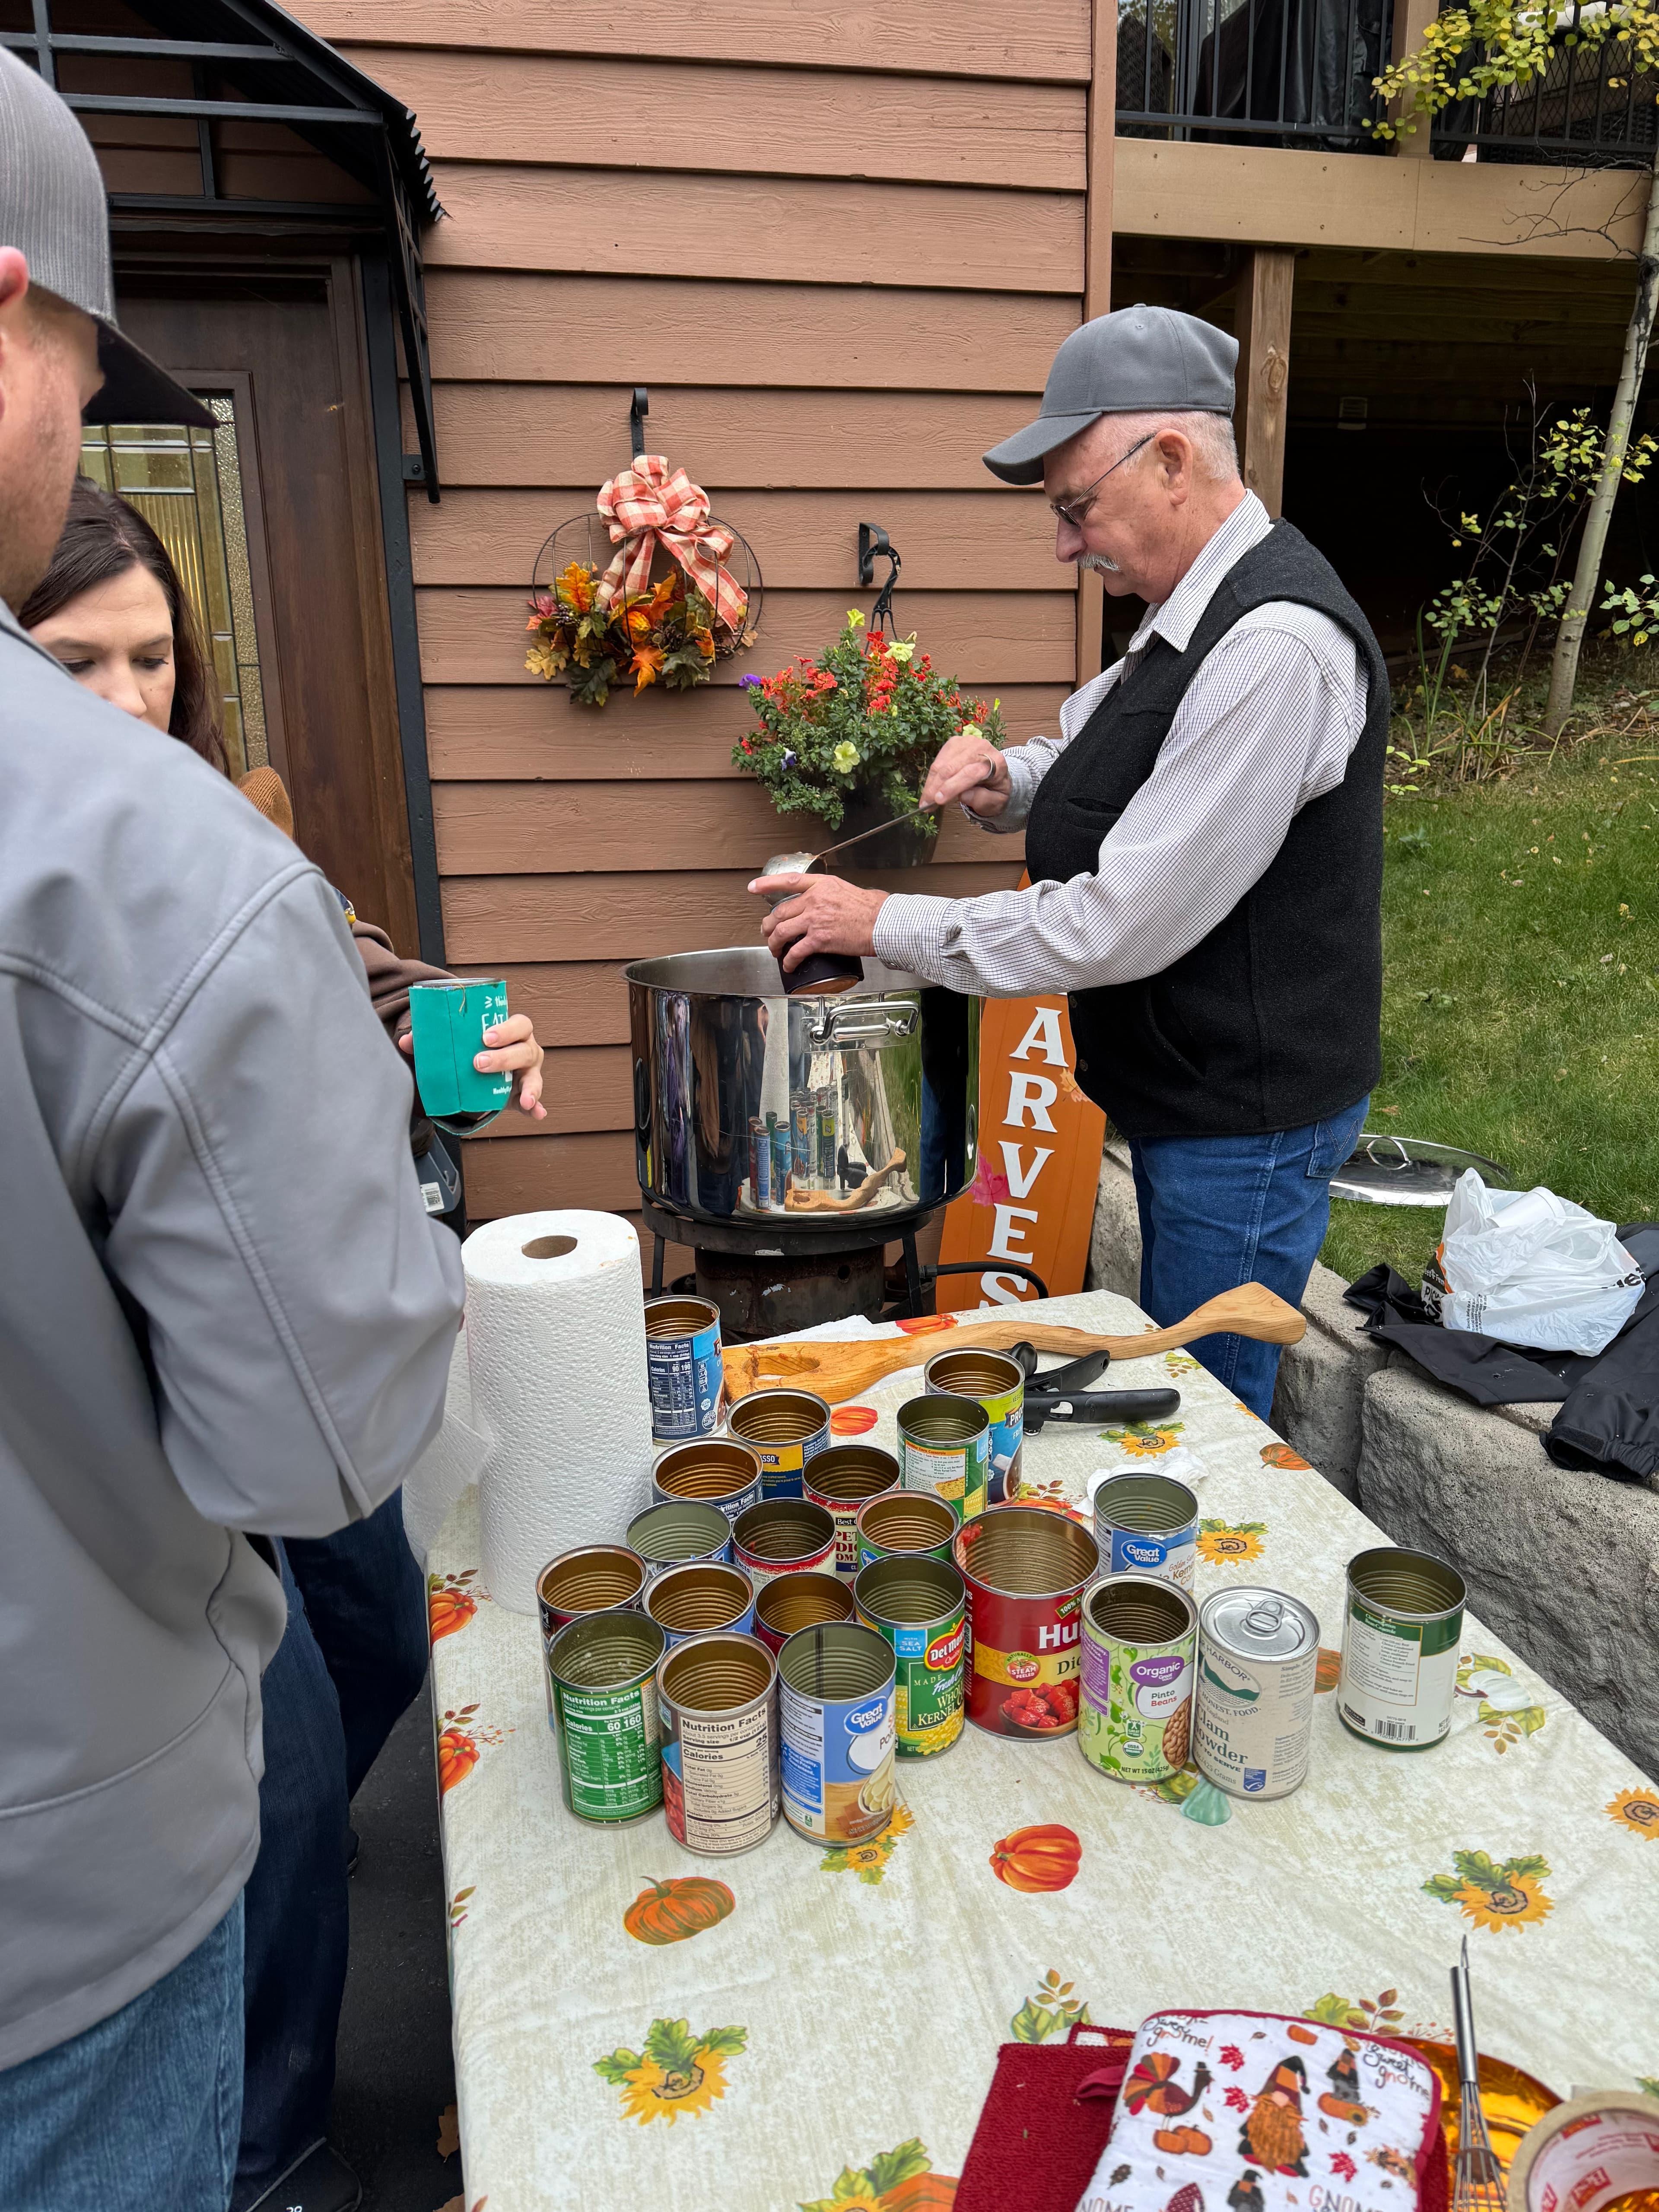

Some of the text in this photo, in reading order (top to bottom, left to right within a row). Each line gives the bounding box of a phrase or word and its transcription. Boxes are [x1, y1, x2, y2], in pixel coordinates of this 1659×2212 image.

[978, 992, 1069, 1309] ARVES
[741, 1494, 753, 1505] Facts
[1127, 1544, 1160, 1563] Great Value
[1169, 1560, 1185, 1572] Golden
[1060, 1600, 1076, 1615] 100%
[1039, 1622, 1079, 1649] Hu
[930, 1645, 948, 1662] Del
[1007, 1652, 1033, 1662] NATURALLY
[1011, 1666, 1036, 1675] STEAM
[1136, 1662, 1181, 1678] Organic
[914, 1674, 942, 1686] MADE
[563, 1690, 640, 1706] Nutrition Facts
[1151, 1690, 1175, 1699] Pinto
[1151, 1696, 1177, 1707] Beans
[1201, 1692, 1262, 1716] HONEST. FOOD.
[624, 1714, 641, 1728] 160
[682, 1708, 766, 1732] Nutrition Facts
[851, 1703, 883, 1728] Great Value
[918, 1702, 957, 1726] KERNEL
[566, 1718, 593, 1732] Calories
[607, 1722, 620, 1731] 60
[740, 1721, 761, 1734] container
[1196, 1703, 1230, 1742] Clam
[683, 1734, 705, 1744] Serving
[756, 1732, 767, 1748] 25
[683, 1748, 724, 1760] Calories
[1204, 1747, 1241, 1772] TO SERVE
[1155, 1764, 1169, 1773] (425g)
[685, 1779, 712, 1788] Cholesterol
[1214, 1769, 1236, 1785] Grams
[1309, 2184, 1383, 2212] GNO
